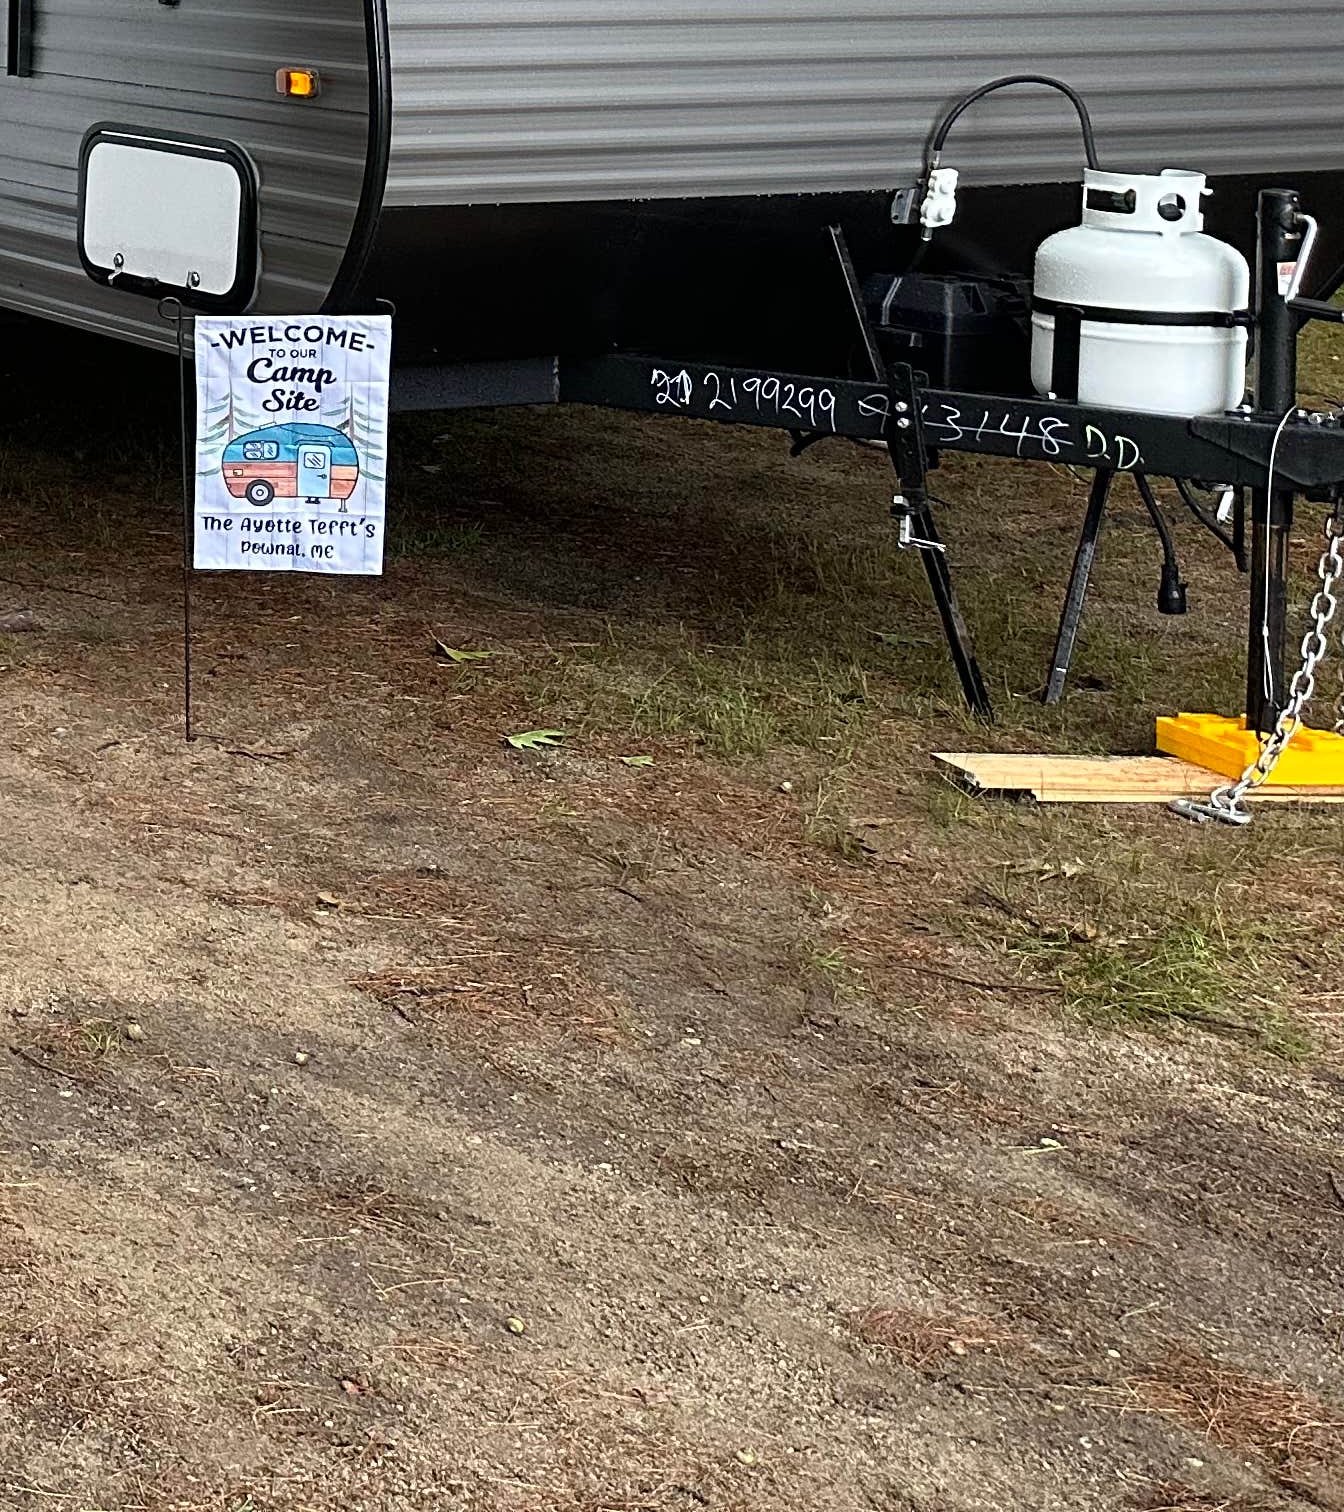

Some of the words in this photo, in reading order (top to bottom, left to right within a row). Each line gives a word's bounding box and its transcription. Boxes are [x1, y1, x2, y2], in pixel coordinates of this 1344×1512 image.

[268, 348, 286, 359] TO
[290, 348, 317, 359] OUR
[246, 357, 337, 393] Camp
[262, 388, 320, 412] Site
[201, 516, 233, 531] The
[241, 517, 302, 534] Ayotte
[311, 544, 334, 559] ME
